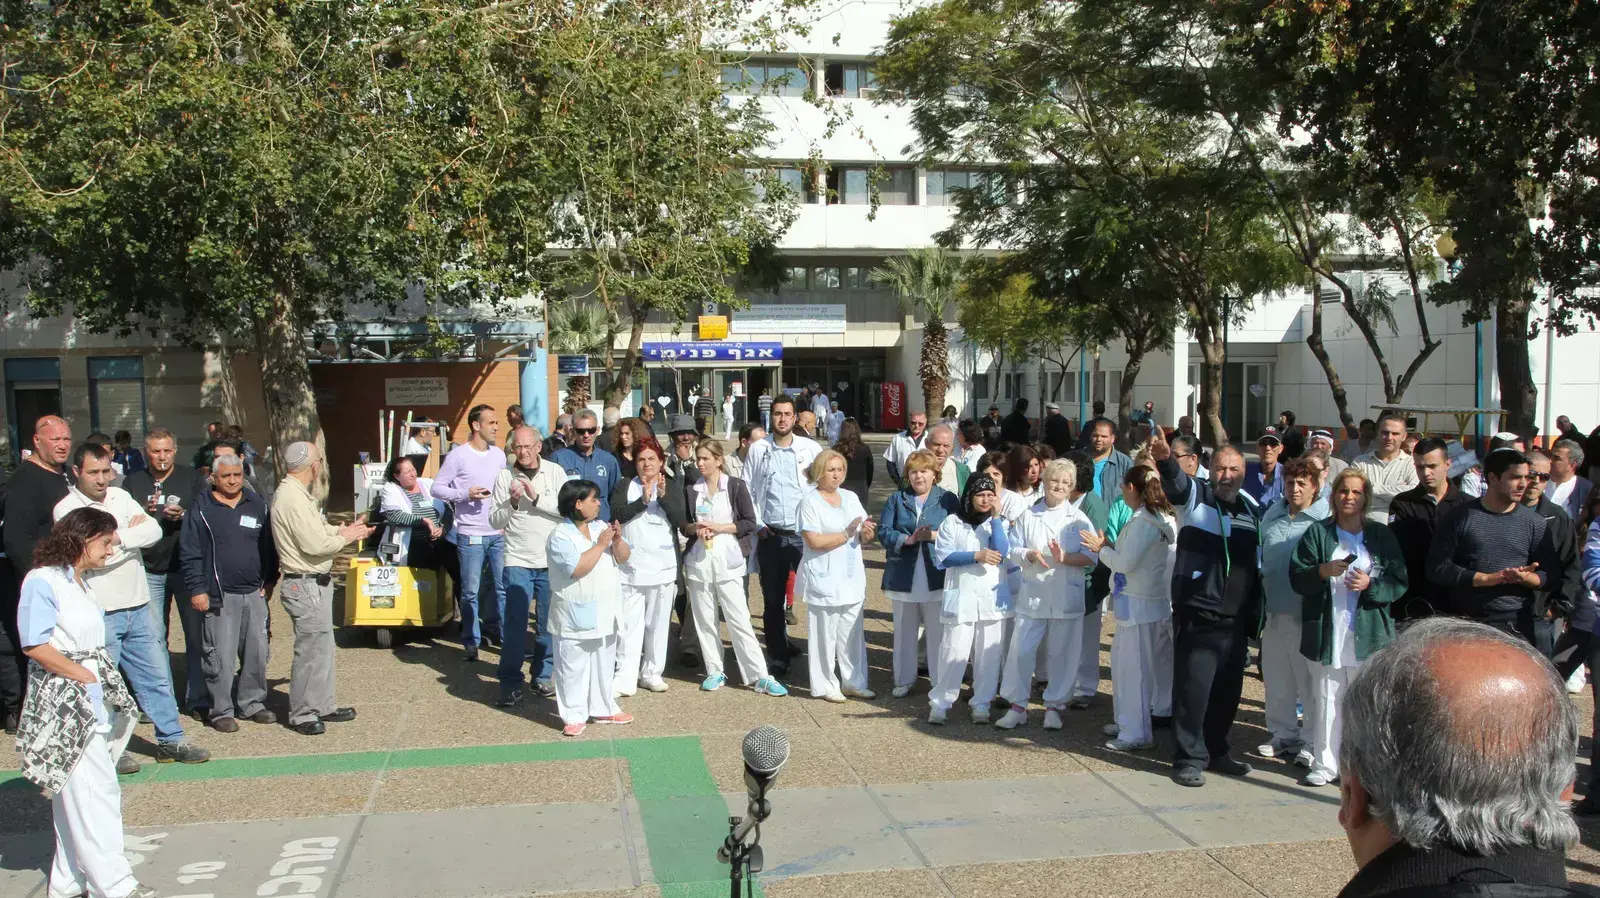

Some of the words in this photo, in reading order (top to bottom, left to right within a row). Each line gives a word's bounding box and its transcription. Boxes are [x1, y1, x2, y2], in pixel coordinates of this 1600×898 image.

[707, 304, 714, 313] 2
[650, 348, 717, 358] פנימי
[728, 348, 774, 360] אגף
[376, 568, 390, 580] 20
